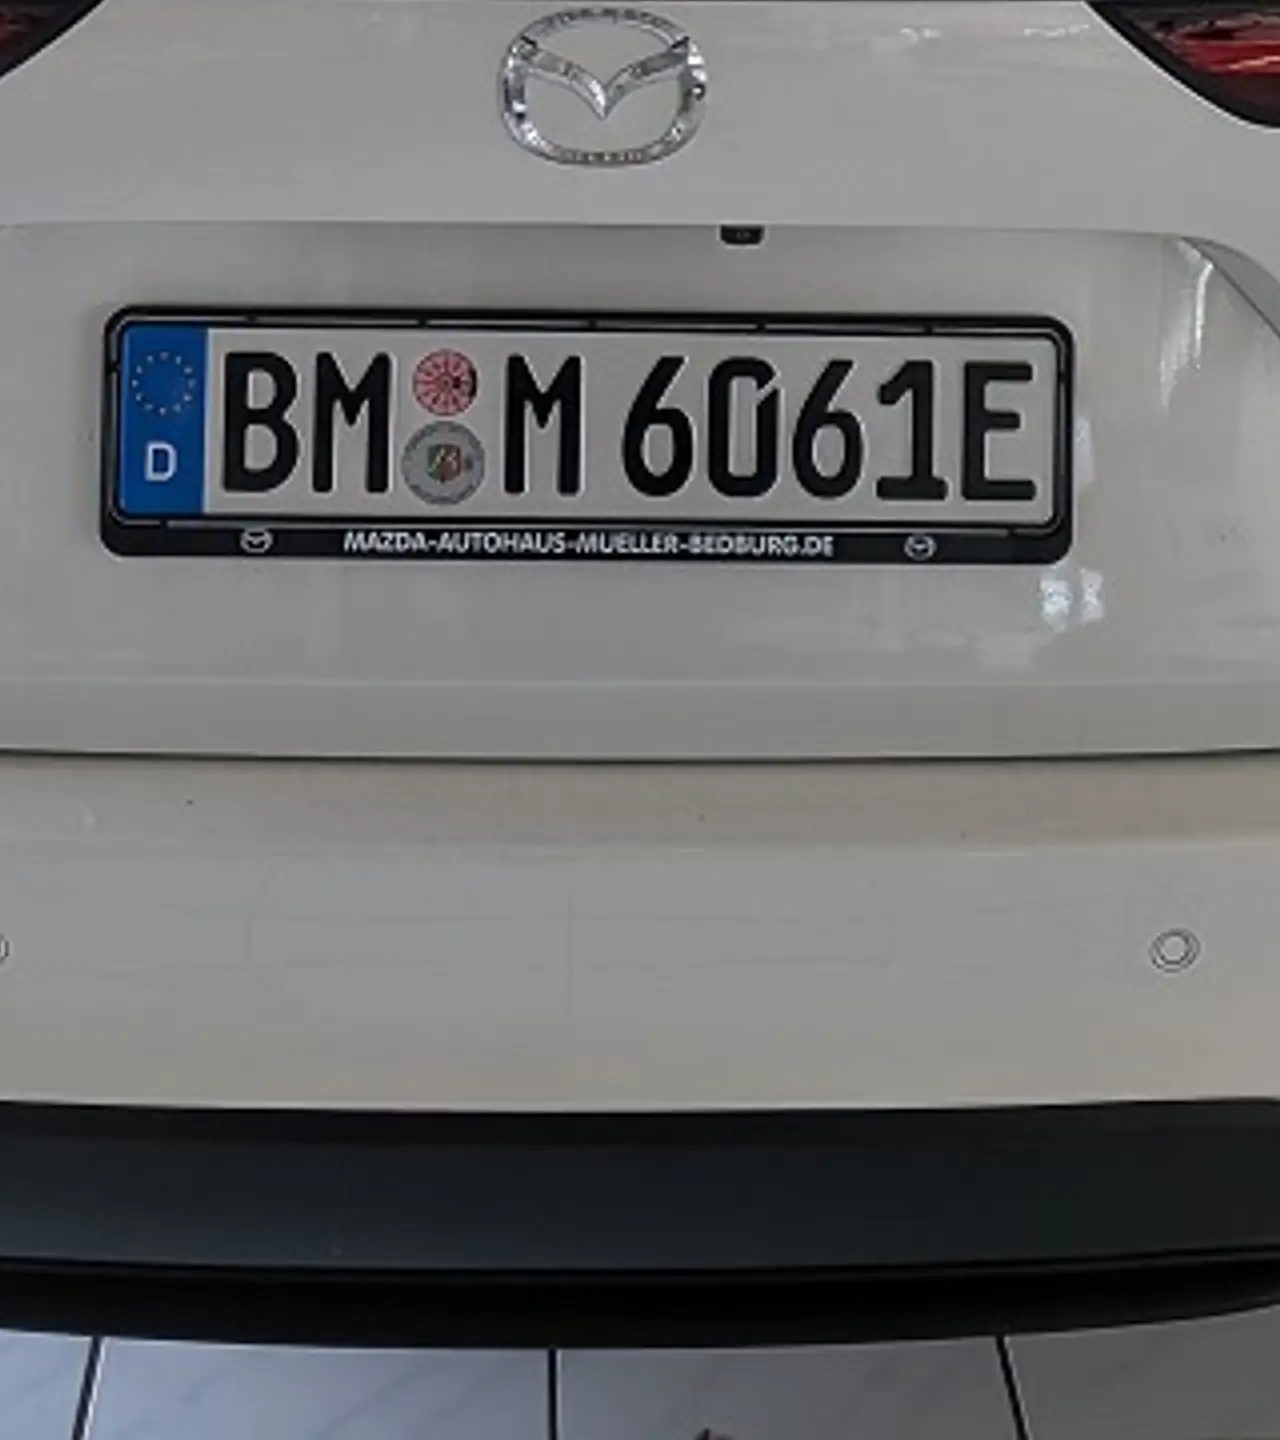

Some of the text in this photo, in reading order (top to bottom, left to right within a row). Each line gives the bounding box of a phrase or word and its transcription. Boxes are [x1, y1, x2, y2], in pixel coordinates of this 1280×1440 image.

[144, 441, 178, 482] D
[223, 351, 392, 493] BM
[503, 353, 584, 494] M
[622, 355, 1038, 502] 6061E
